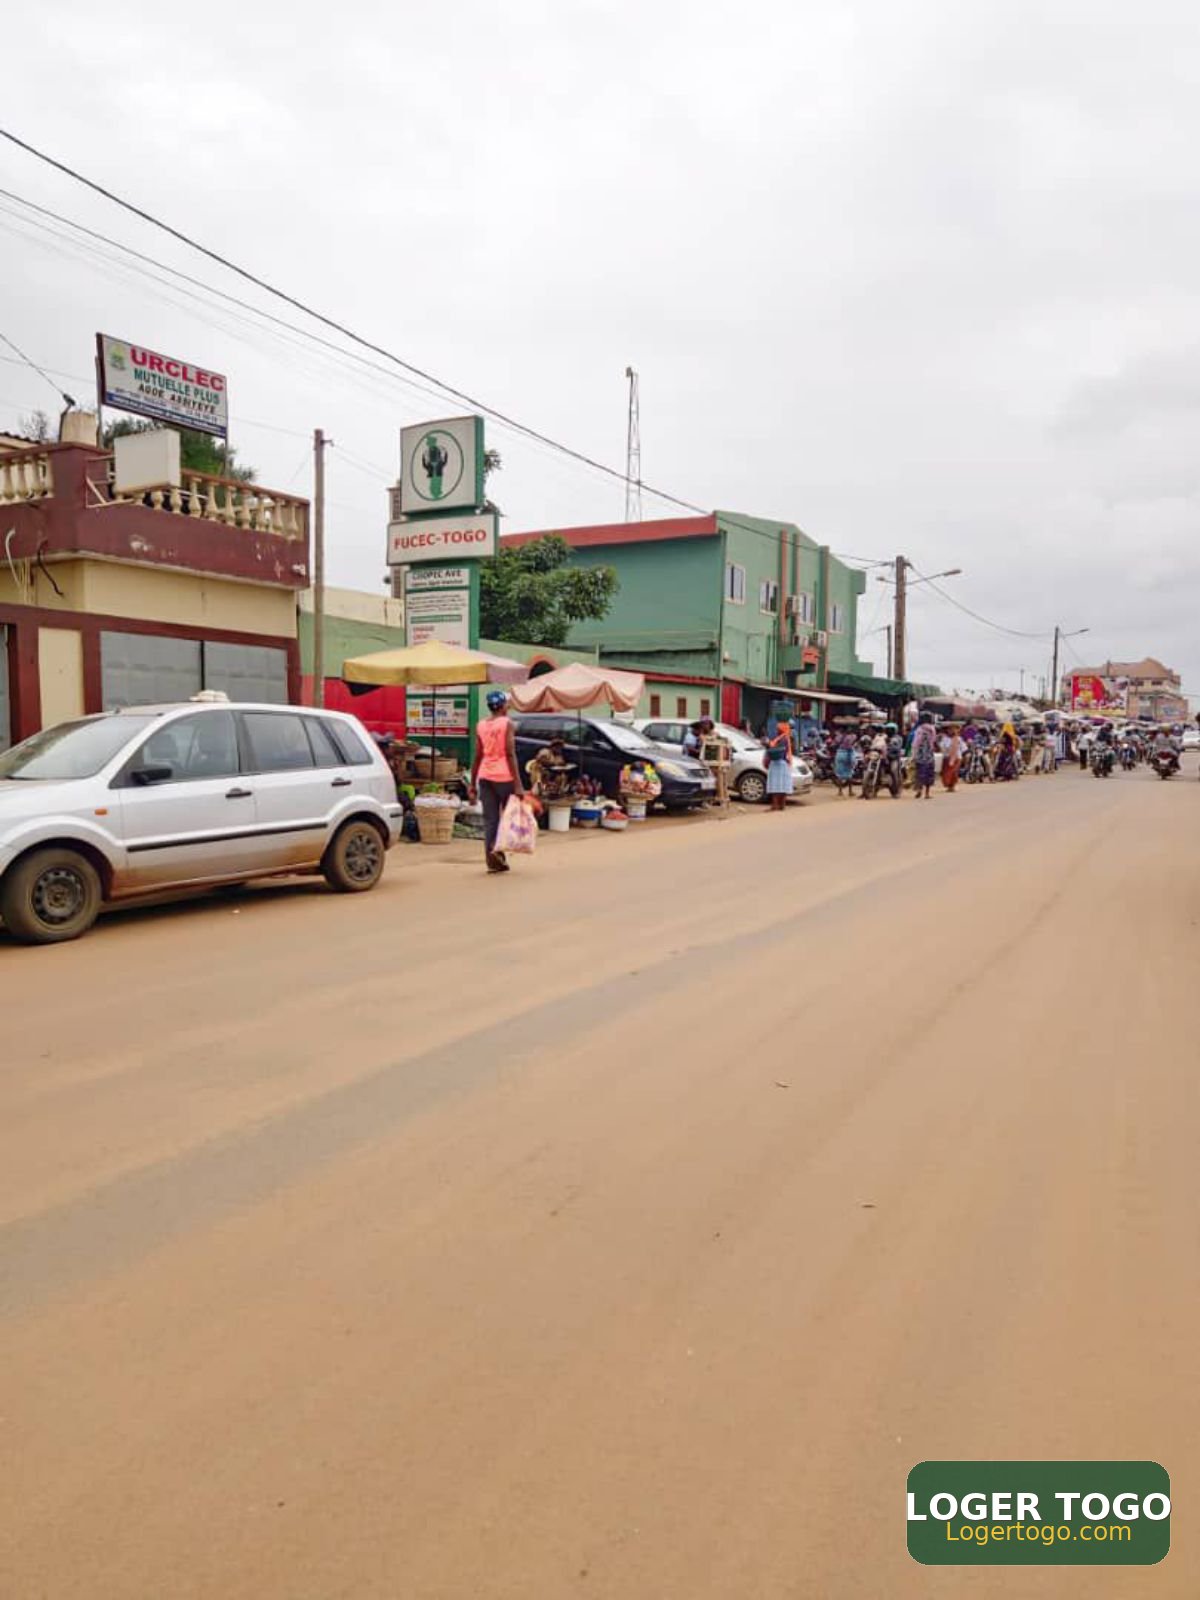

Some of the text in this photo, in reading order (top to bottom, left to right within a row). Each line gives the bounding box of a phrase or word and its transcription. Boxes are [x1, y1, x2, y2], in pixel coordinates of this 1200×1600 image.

[130, 347, 224, 391] URCLEC
[134, 368, 191, 397] MUTUELLE
[193, 387, 220, 405] PLUS
[393, 529, 487, 550] FUCEC-TOGO
